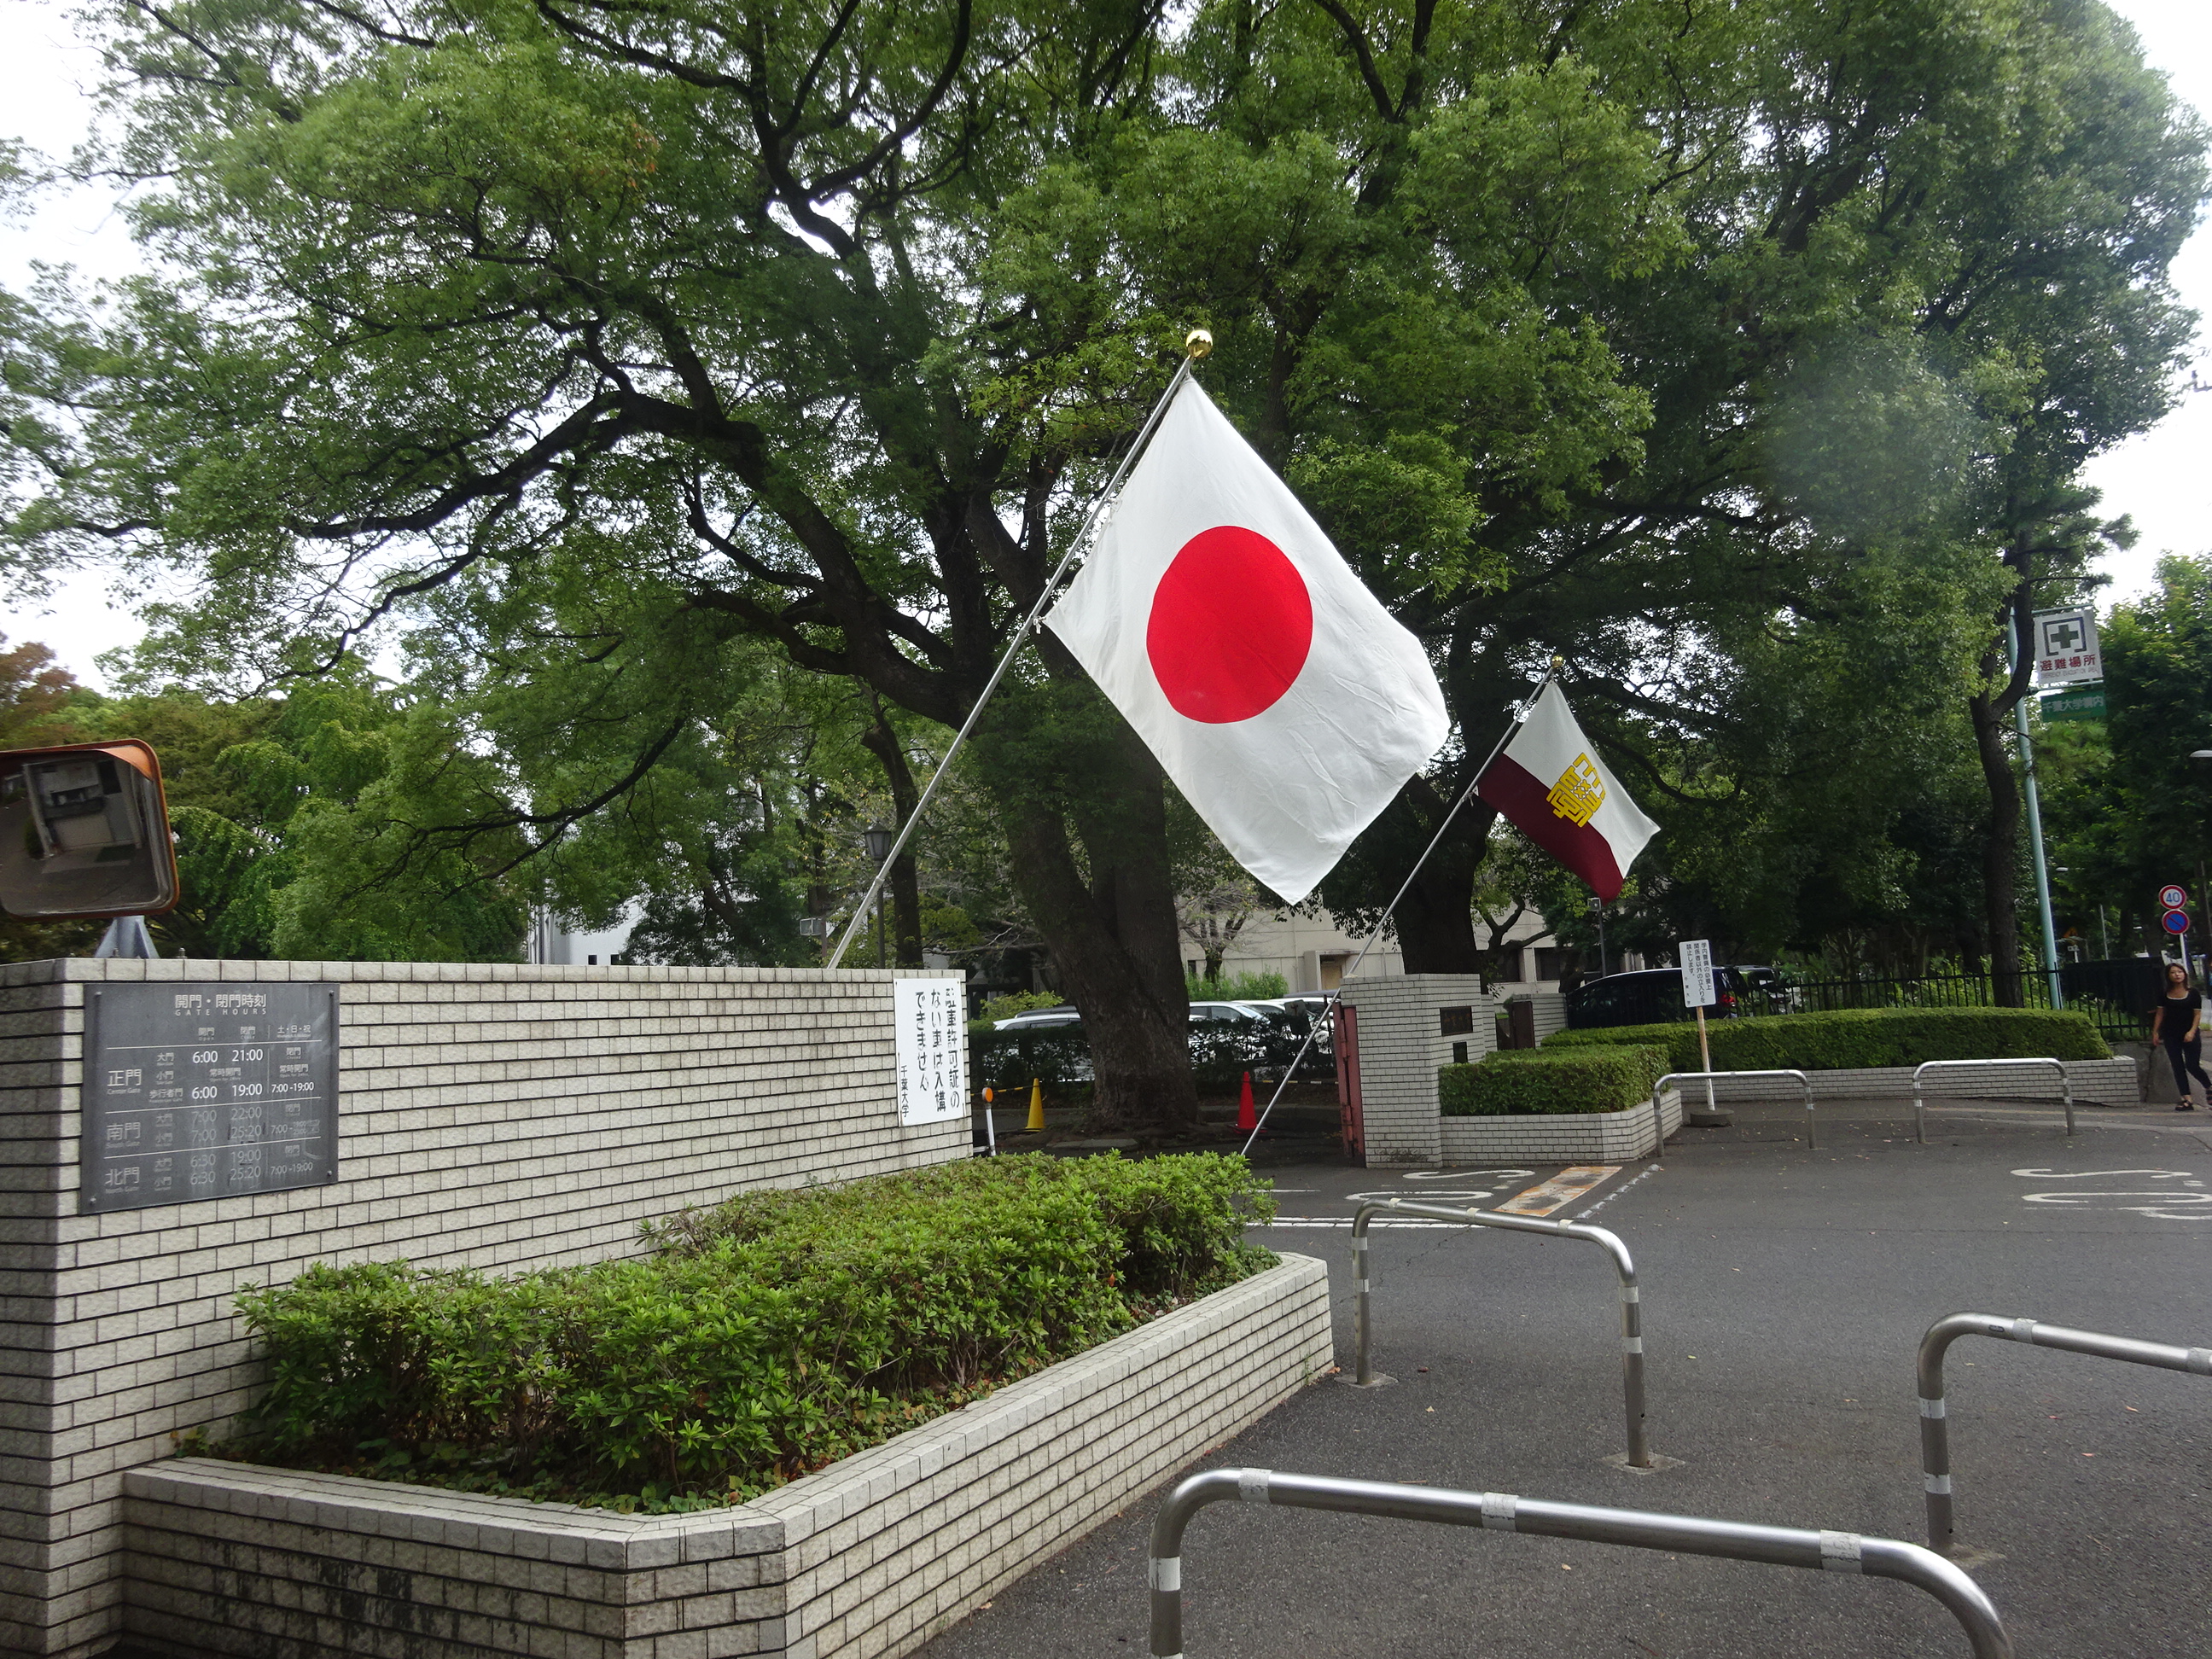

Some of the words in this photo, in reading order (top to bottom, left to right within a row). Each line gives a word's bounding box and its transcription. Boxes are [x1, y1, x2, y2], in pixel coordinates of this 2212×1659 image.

[2040, 655, 2096, 672] 避難場所
[2166, 893, 2180, 903] 40
[175, 994, 266, 1008] 開門・閉門時刻
[915, 991, 929, 1091] できません
[157, 1052, 174, 1062] 大門
[192, 1051, 218, 1063] 6:00
[232, 1049, 264, 1062] 21:00
[931, 988, 946, 1112] ない車は入構
[108, 1069, 142, 1086] 正門
[192, 1086, 218, 1100] 6:00
[232, 1084, 263, 1097] 19:00
[900, 1065, 909, 1118] 千葉大学
[191, 1110, 217, 1124] 7:00
[231, 1107, 262, 1121] 22:00
[106, 1122, 141, 1141] 南門
[191, 1129, 217, 1144] 7:00
[230, 1126, 261, 1139] 25:20
[190, 1154, 216, 1167] 6:30
[231, 1150, 261, 1163] 19:00
[105, 1167, 140, 1186] 北門
[190, 1171, 216, 1185] 6:30
[230, 1166, 261, 1180] 25:20
